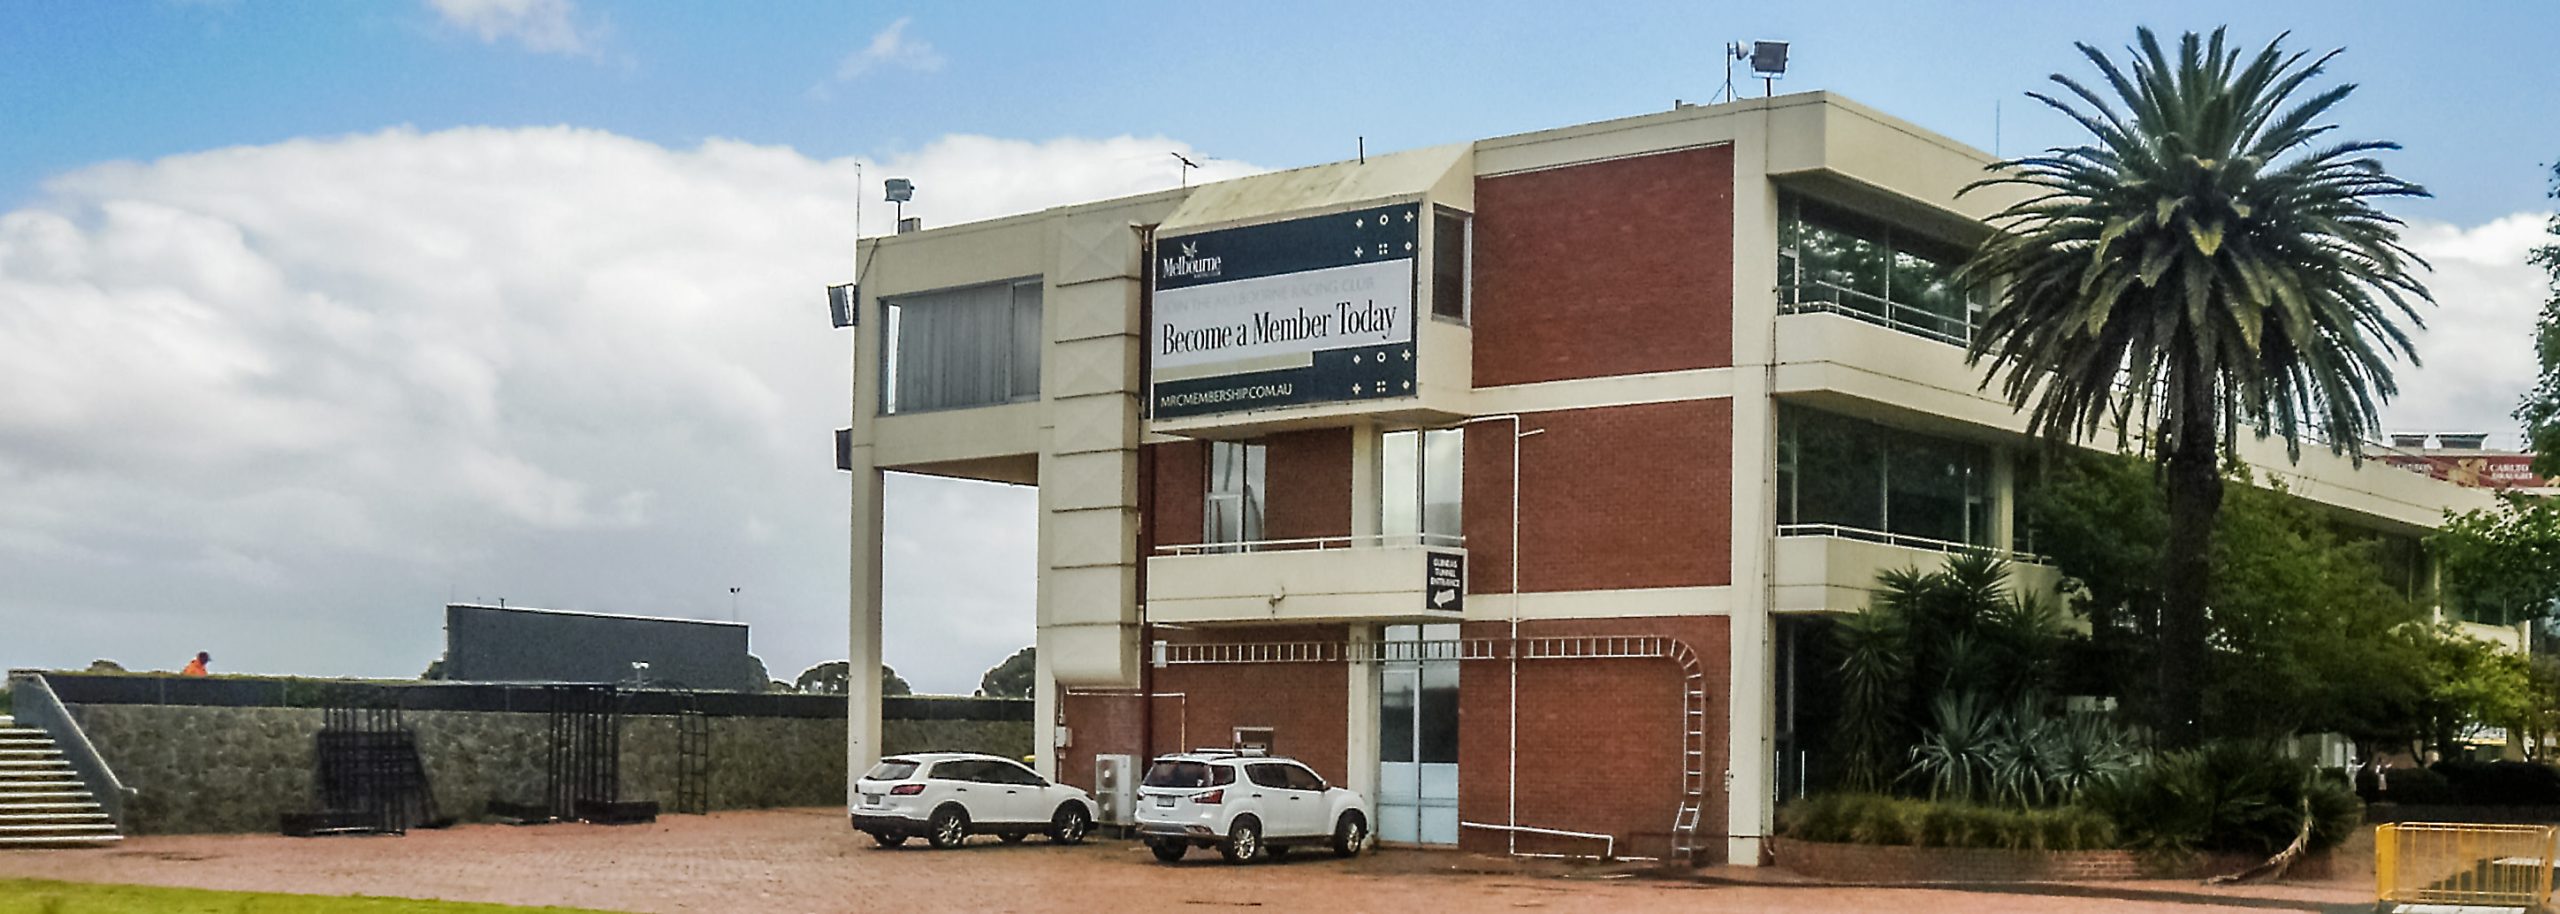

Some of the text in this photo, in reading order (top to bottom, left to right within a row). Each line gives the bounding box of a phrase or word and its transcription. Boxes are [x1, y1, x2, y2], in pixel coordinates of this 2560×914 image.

[1163, 256, 1222, 279] Melbourne
[1341, 276, 1375, 292] CLUB
[1162, 299, 1397, 355] Become a Member Today
[1160, 383, 1293, 408] MRCMEMBERSHIP.COM.AU
[1430, 577, 1460, 587] ENTRANCE
